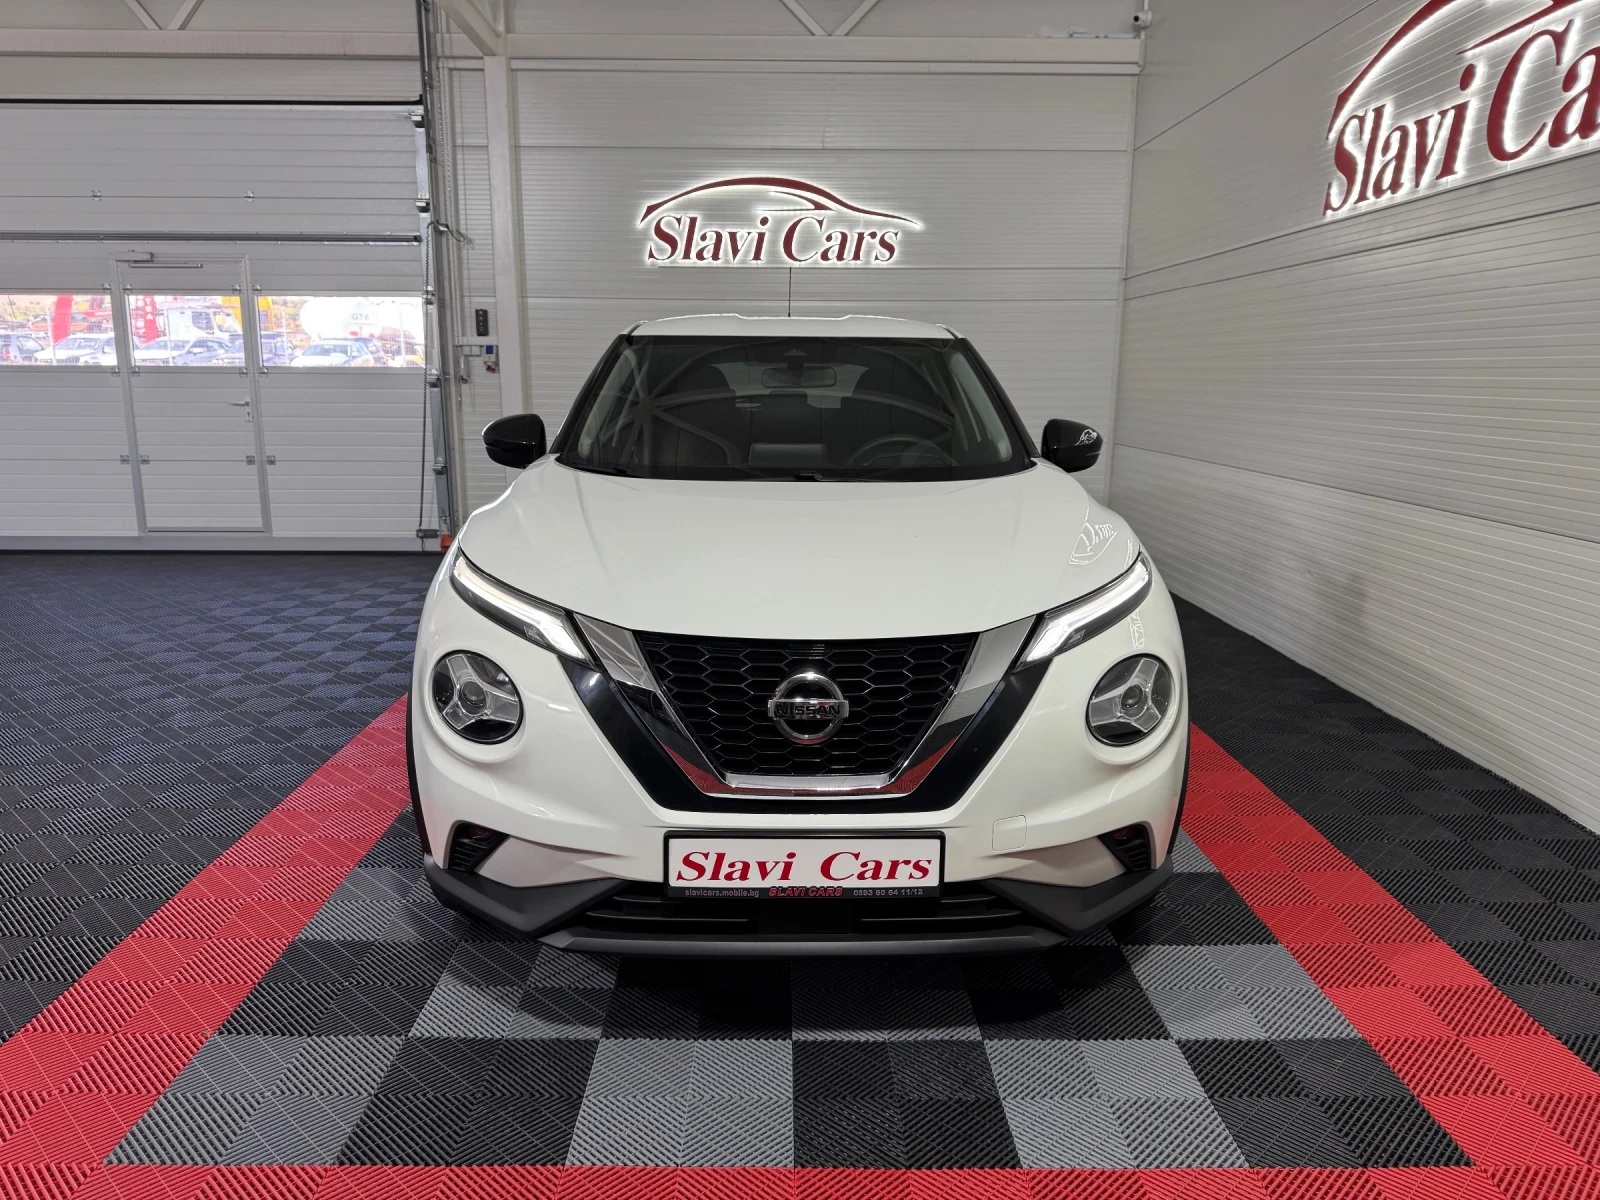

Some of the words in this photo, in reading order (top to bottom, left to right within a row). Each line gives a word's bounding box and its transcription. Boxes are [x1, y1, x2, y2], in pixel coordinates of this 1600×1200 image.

[1322, 63, 1476, 216] Slavi
[647, 215, 770, 262] Slavi
[782, 216, 899, 262] Cars
[774, 702, 840, 717] NISSAN
[676, 851, 797, 881] Slavi
[819, 851, 932, 881] Cars
[684, 888, 760, 898] slavicars.mobile.bg
[768, 886, 805, 897] SLAVI
[807, 886, 843, 897] CARS
[900, 888, 924, 896] 11/12
